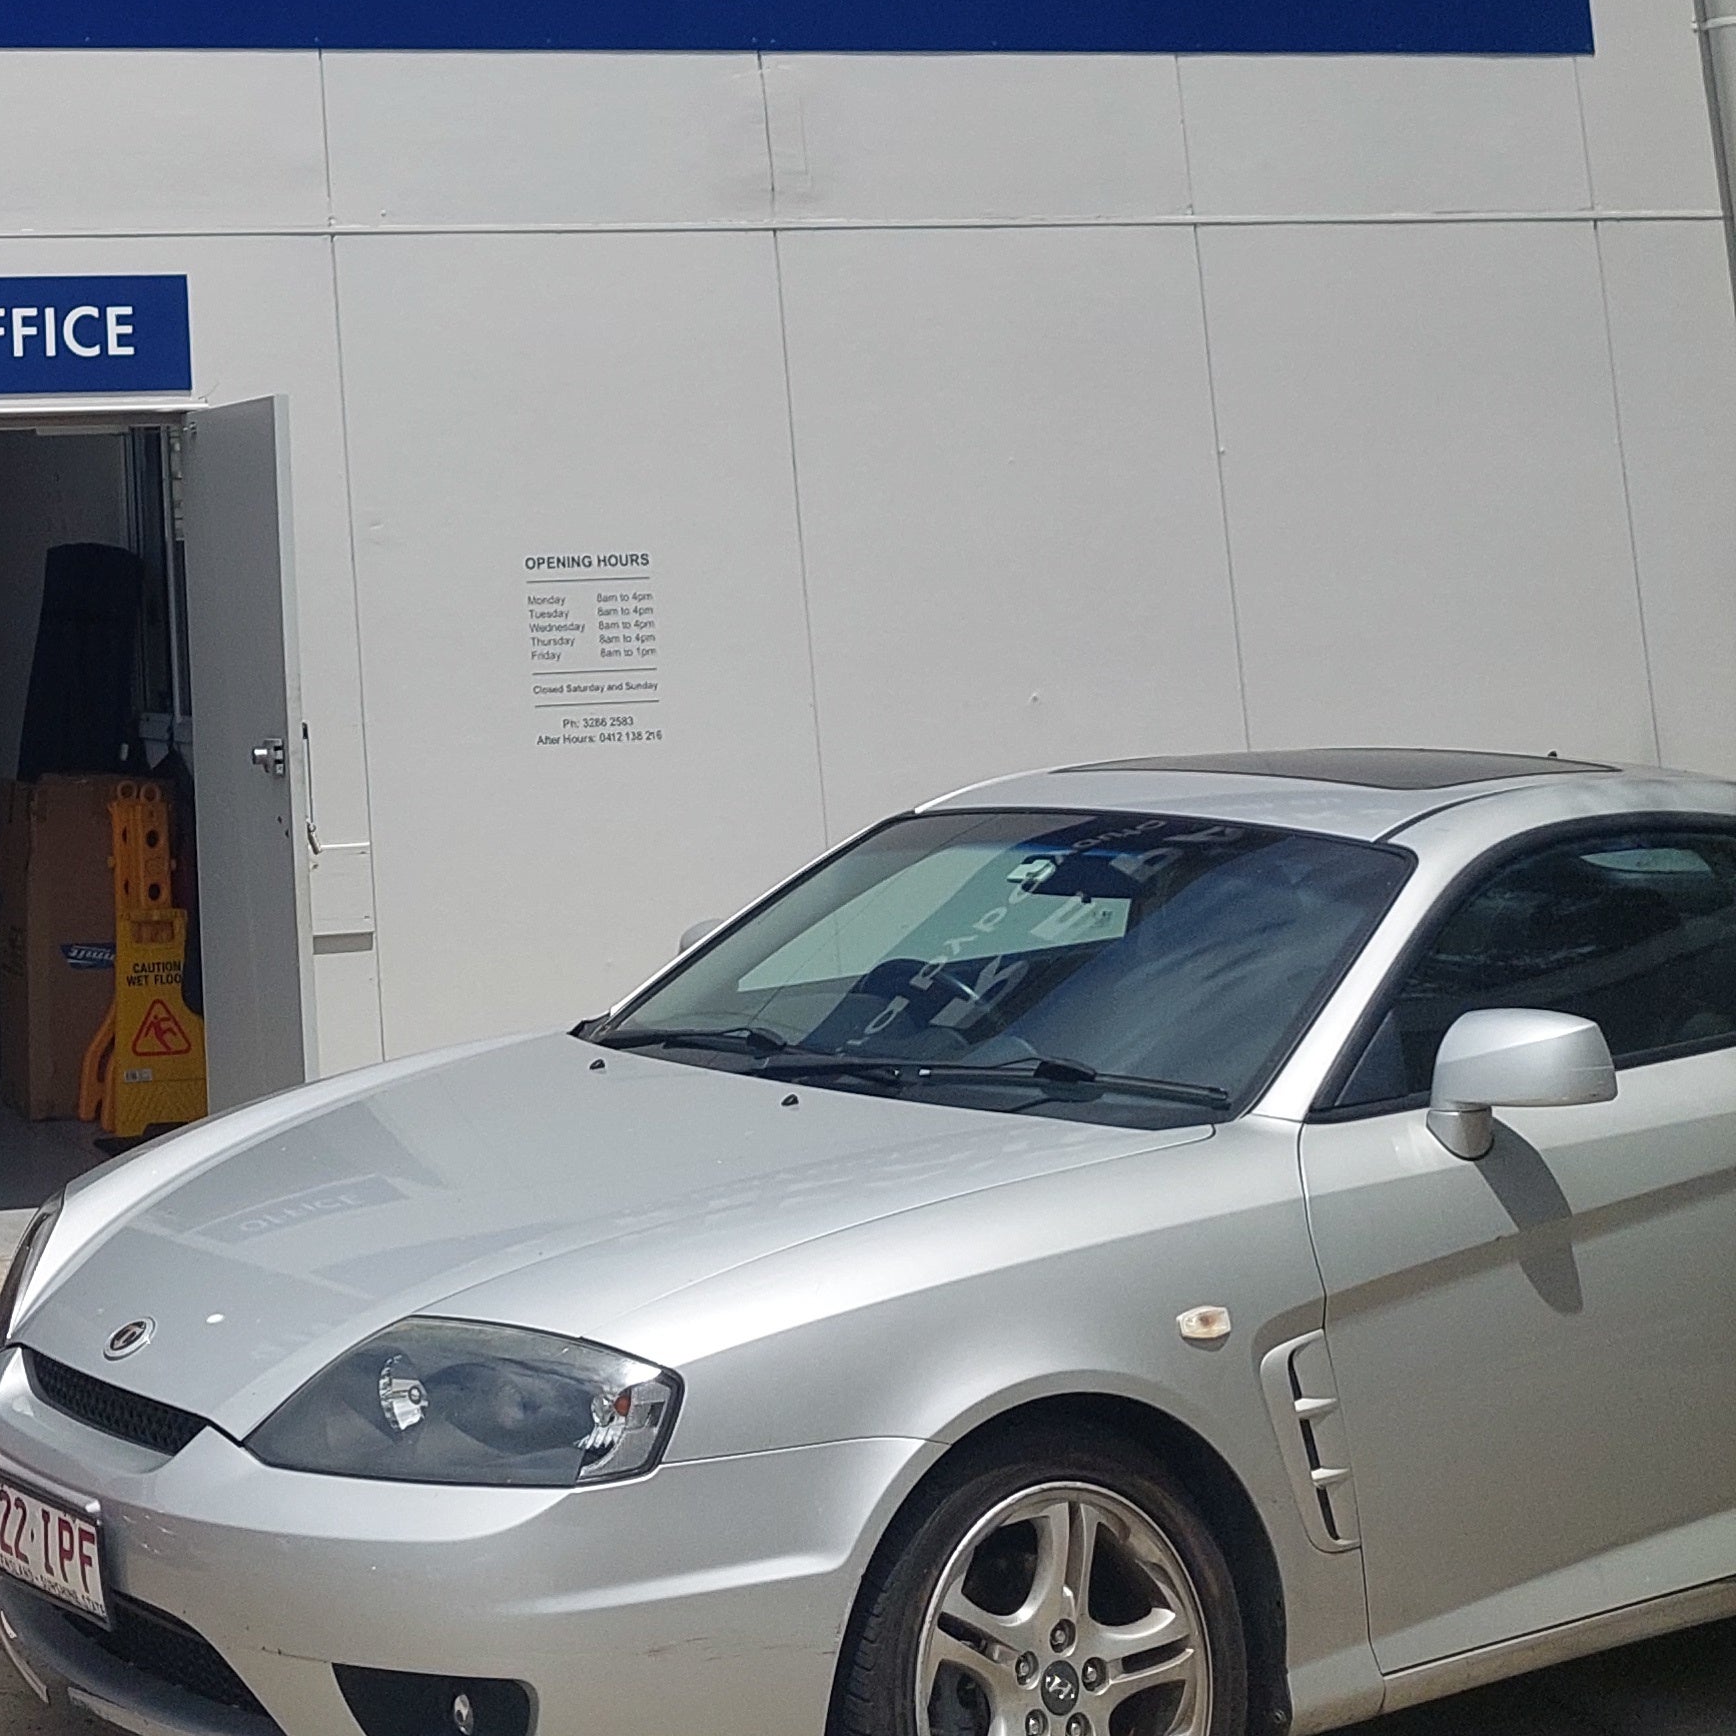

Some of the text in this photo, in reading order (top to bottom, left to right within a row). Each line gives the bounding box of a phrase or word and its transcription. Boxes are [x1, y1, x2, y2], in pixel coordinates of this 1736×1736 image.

[525, 553, 650, 570] OPENING HOURS
[527, 595, 566, 606] Monday
[620, 593, 630, 602] to
[632, 592, 653, 603] 4pm
[529, 609, 569, 619] Tuesday
[621, 607, 630, 616] to
[633, 606, 654, 617] 4pm
[529, 622, 585, 633] Wednesday
[622, 621, 631, 629] to
[531, 636, 575, 647] Thursday
[623, 634, 632, 643] to
[635, 633, 656, 644] 4pm
[531, 650, 562, 661] Friday
[624, 648, 634, 657] to
[533, 681, 658, 695] Closed Saturday and Sunday
[536, 735, 560, 746] After
[562, 733, 596, 744] Hours:
[599, 731, 623, 743] 0412
[132, 961, 181, 974] CAUTION
[126, 973, 183, 986] WET FLOO
